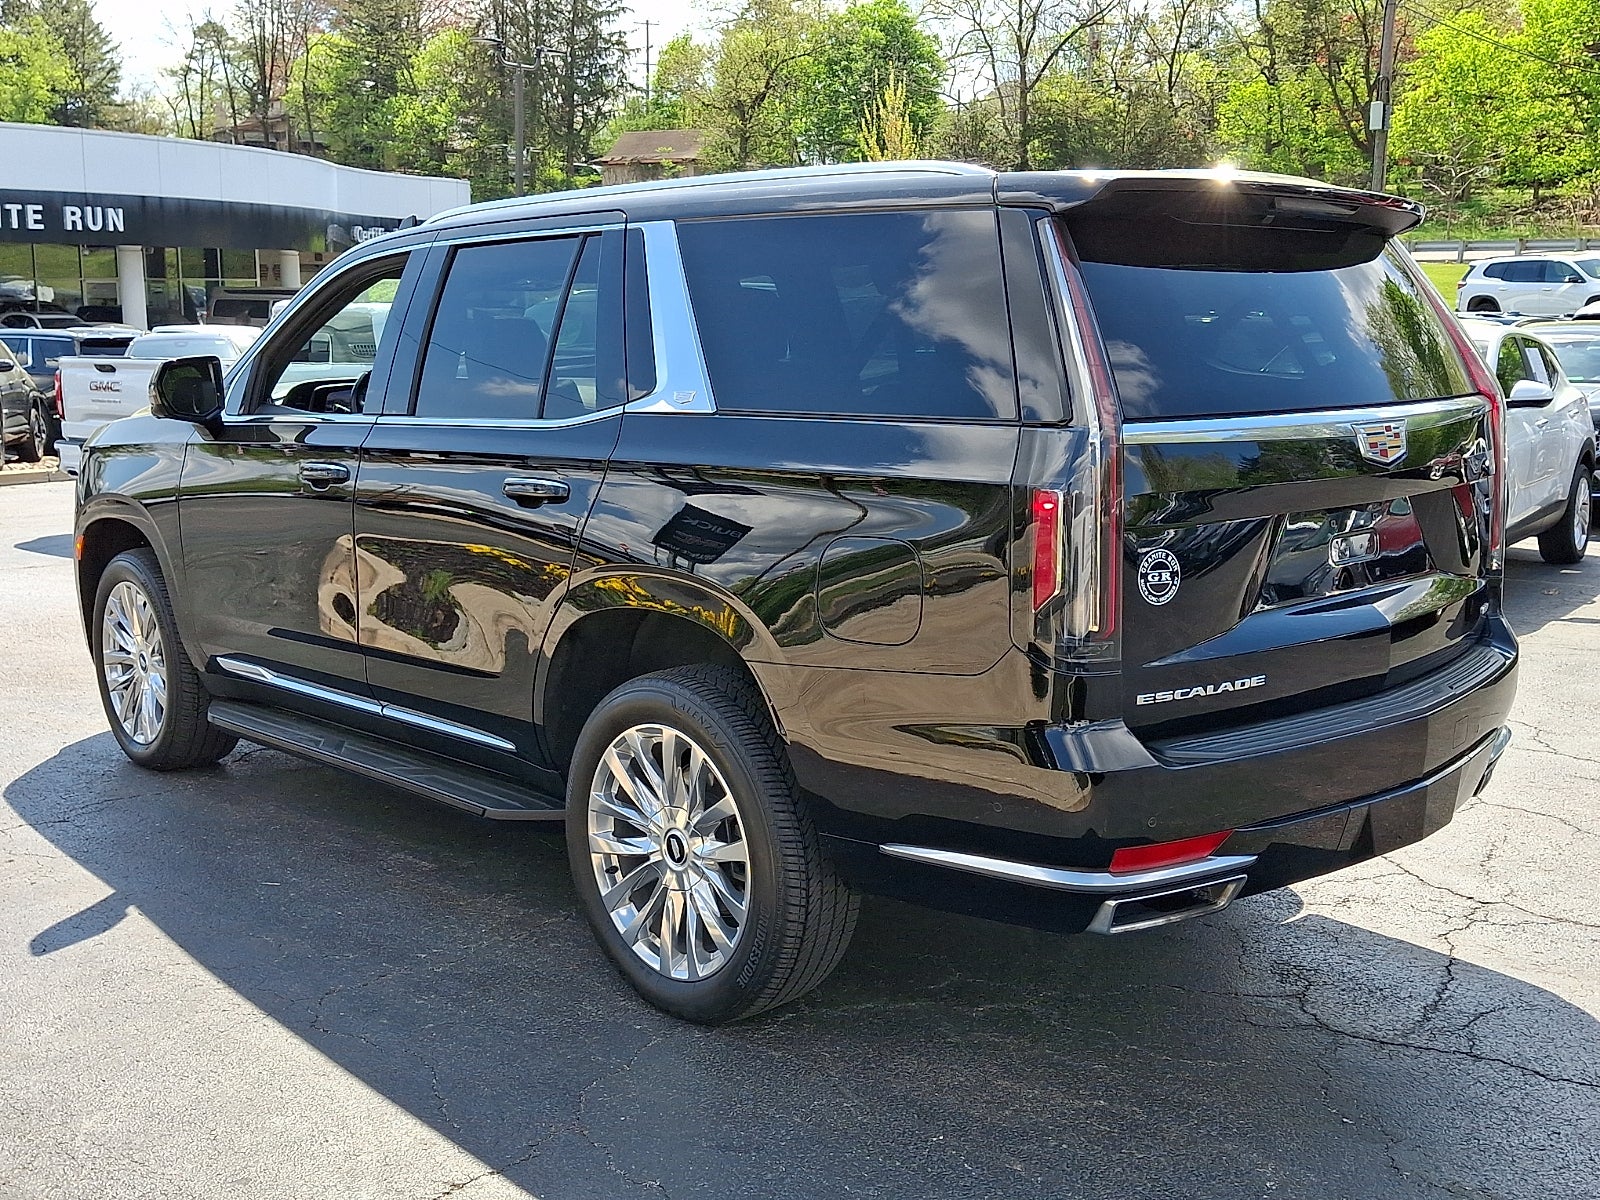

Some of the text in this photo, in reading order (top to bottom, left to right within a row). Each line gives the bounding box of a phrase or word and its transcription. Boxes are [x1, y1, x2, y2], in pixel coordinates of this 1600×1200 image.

[63, 206, 125, 232] RUN
[89, 381, 122, 393] GMC
[1141, 551, 1167, 574] GRANITE
[1147, 572, 1172, 582] GR
[1136, 675, 1267, 706] ESCALADE
[679, 703, 719, 740] ALENZA
